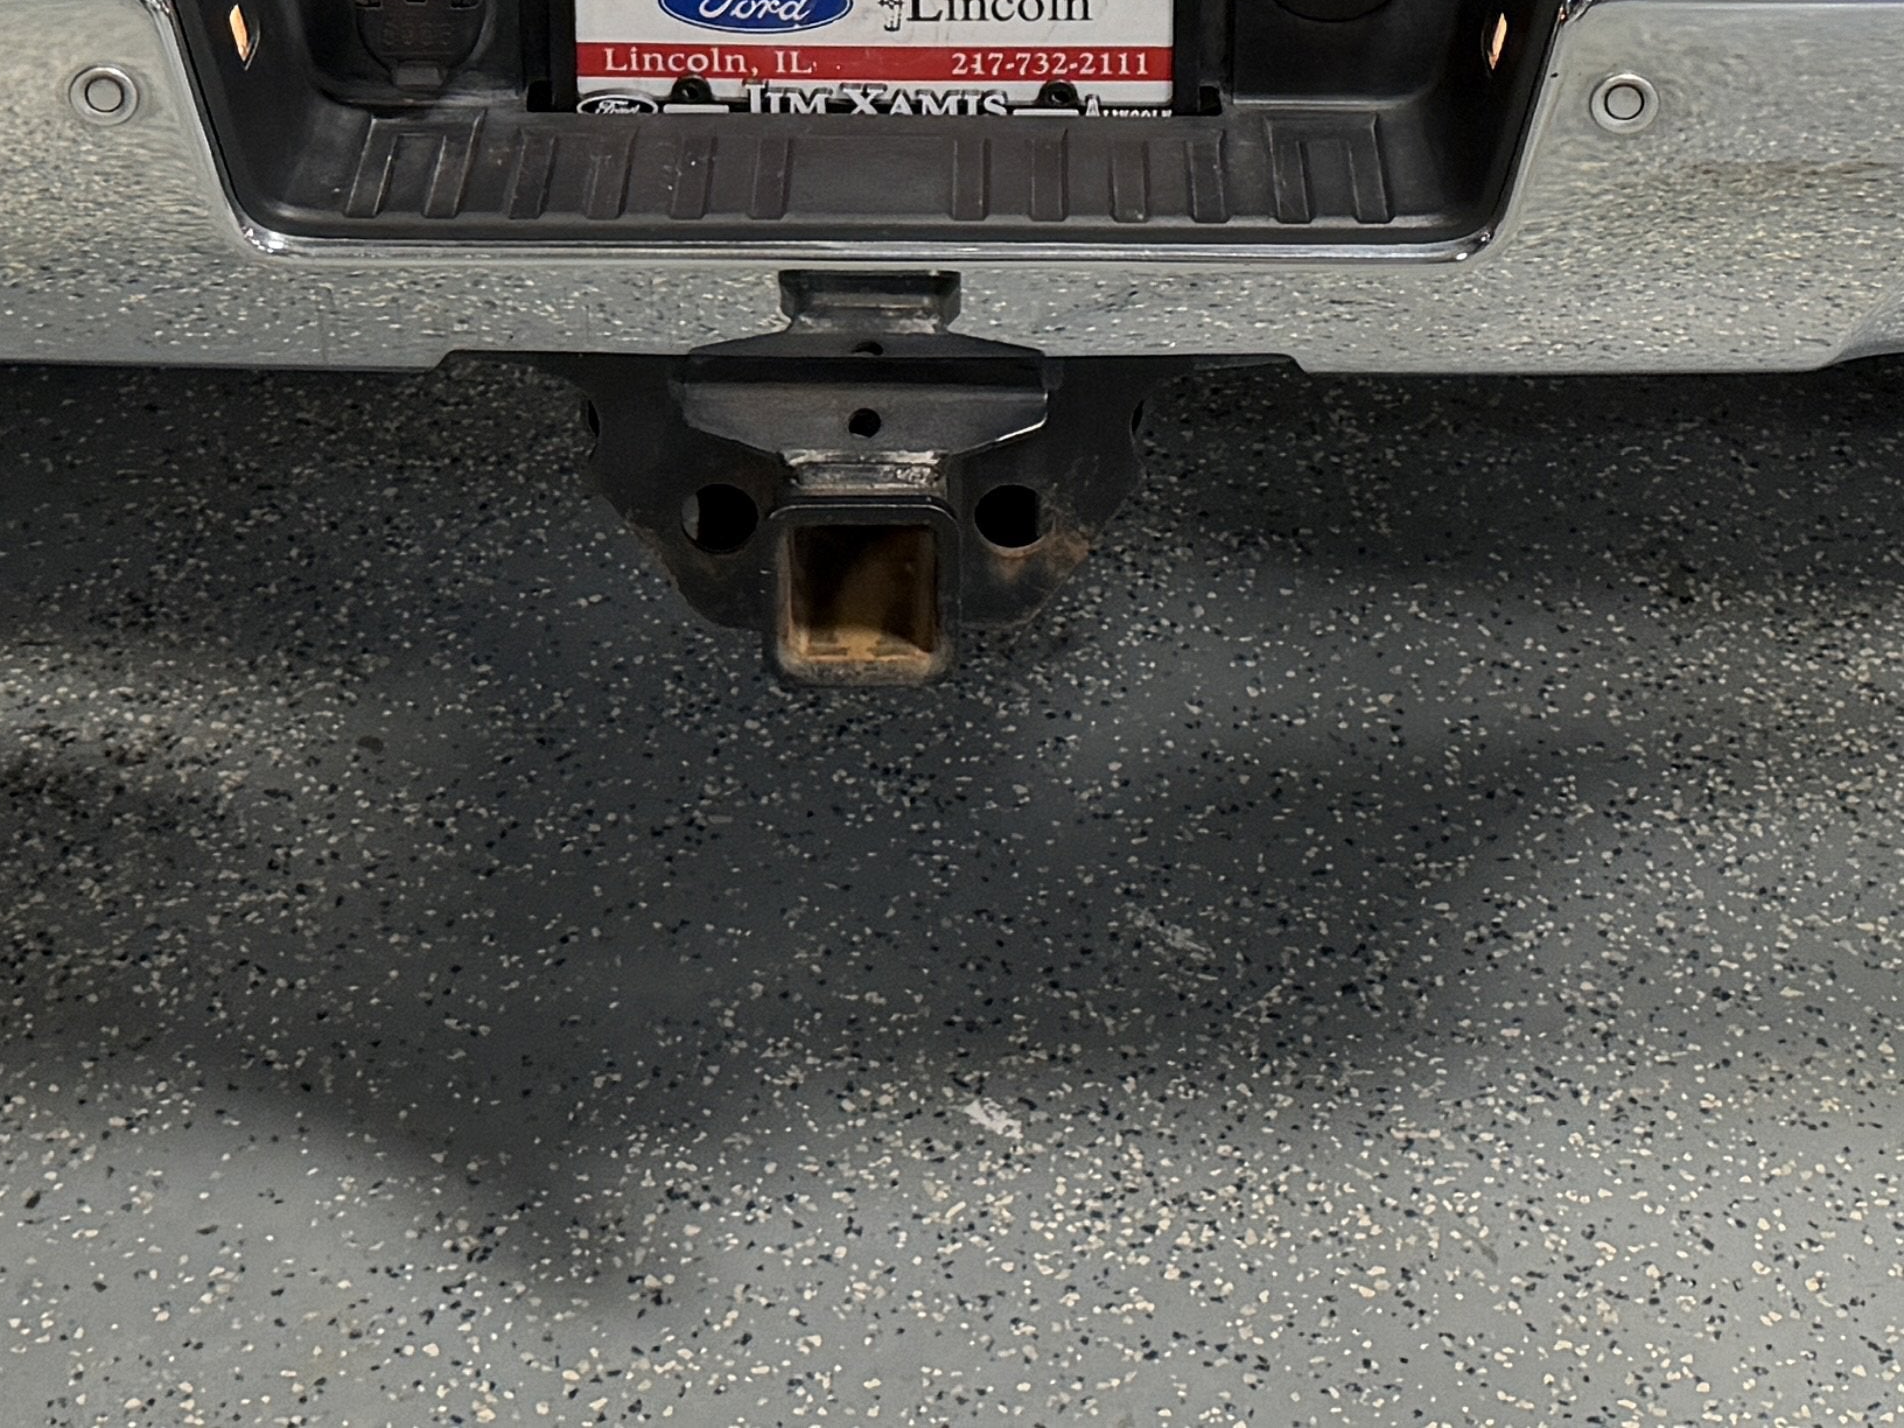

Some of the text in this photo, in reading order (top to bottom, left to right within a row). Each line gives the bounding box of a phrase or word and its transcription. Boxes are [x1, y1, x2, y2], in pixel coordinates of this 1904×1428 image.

[604, 47, 814, 76] Lincoln, IL
[951, 52, 1150, 75] 217-732-2111
